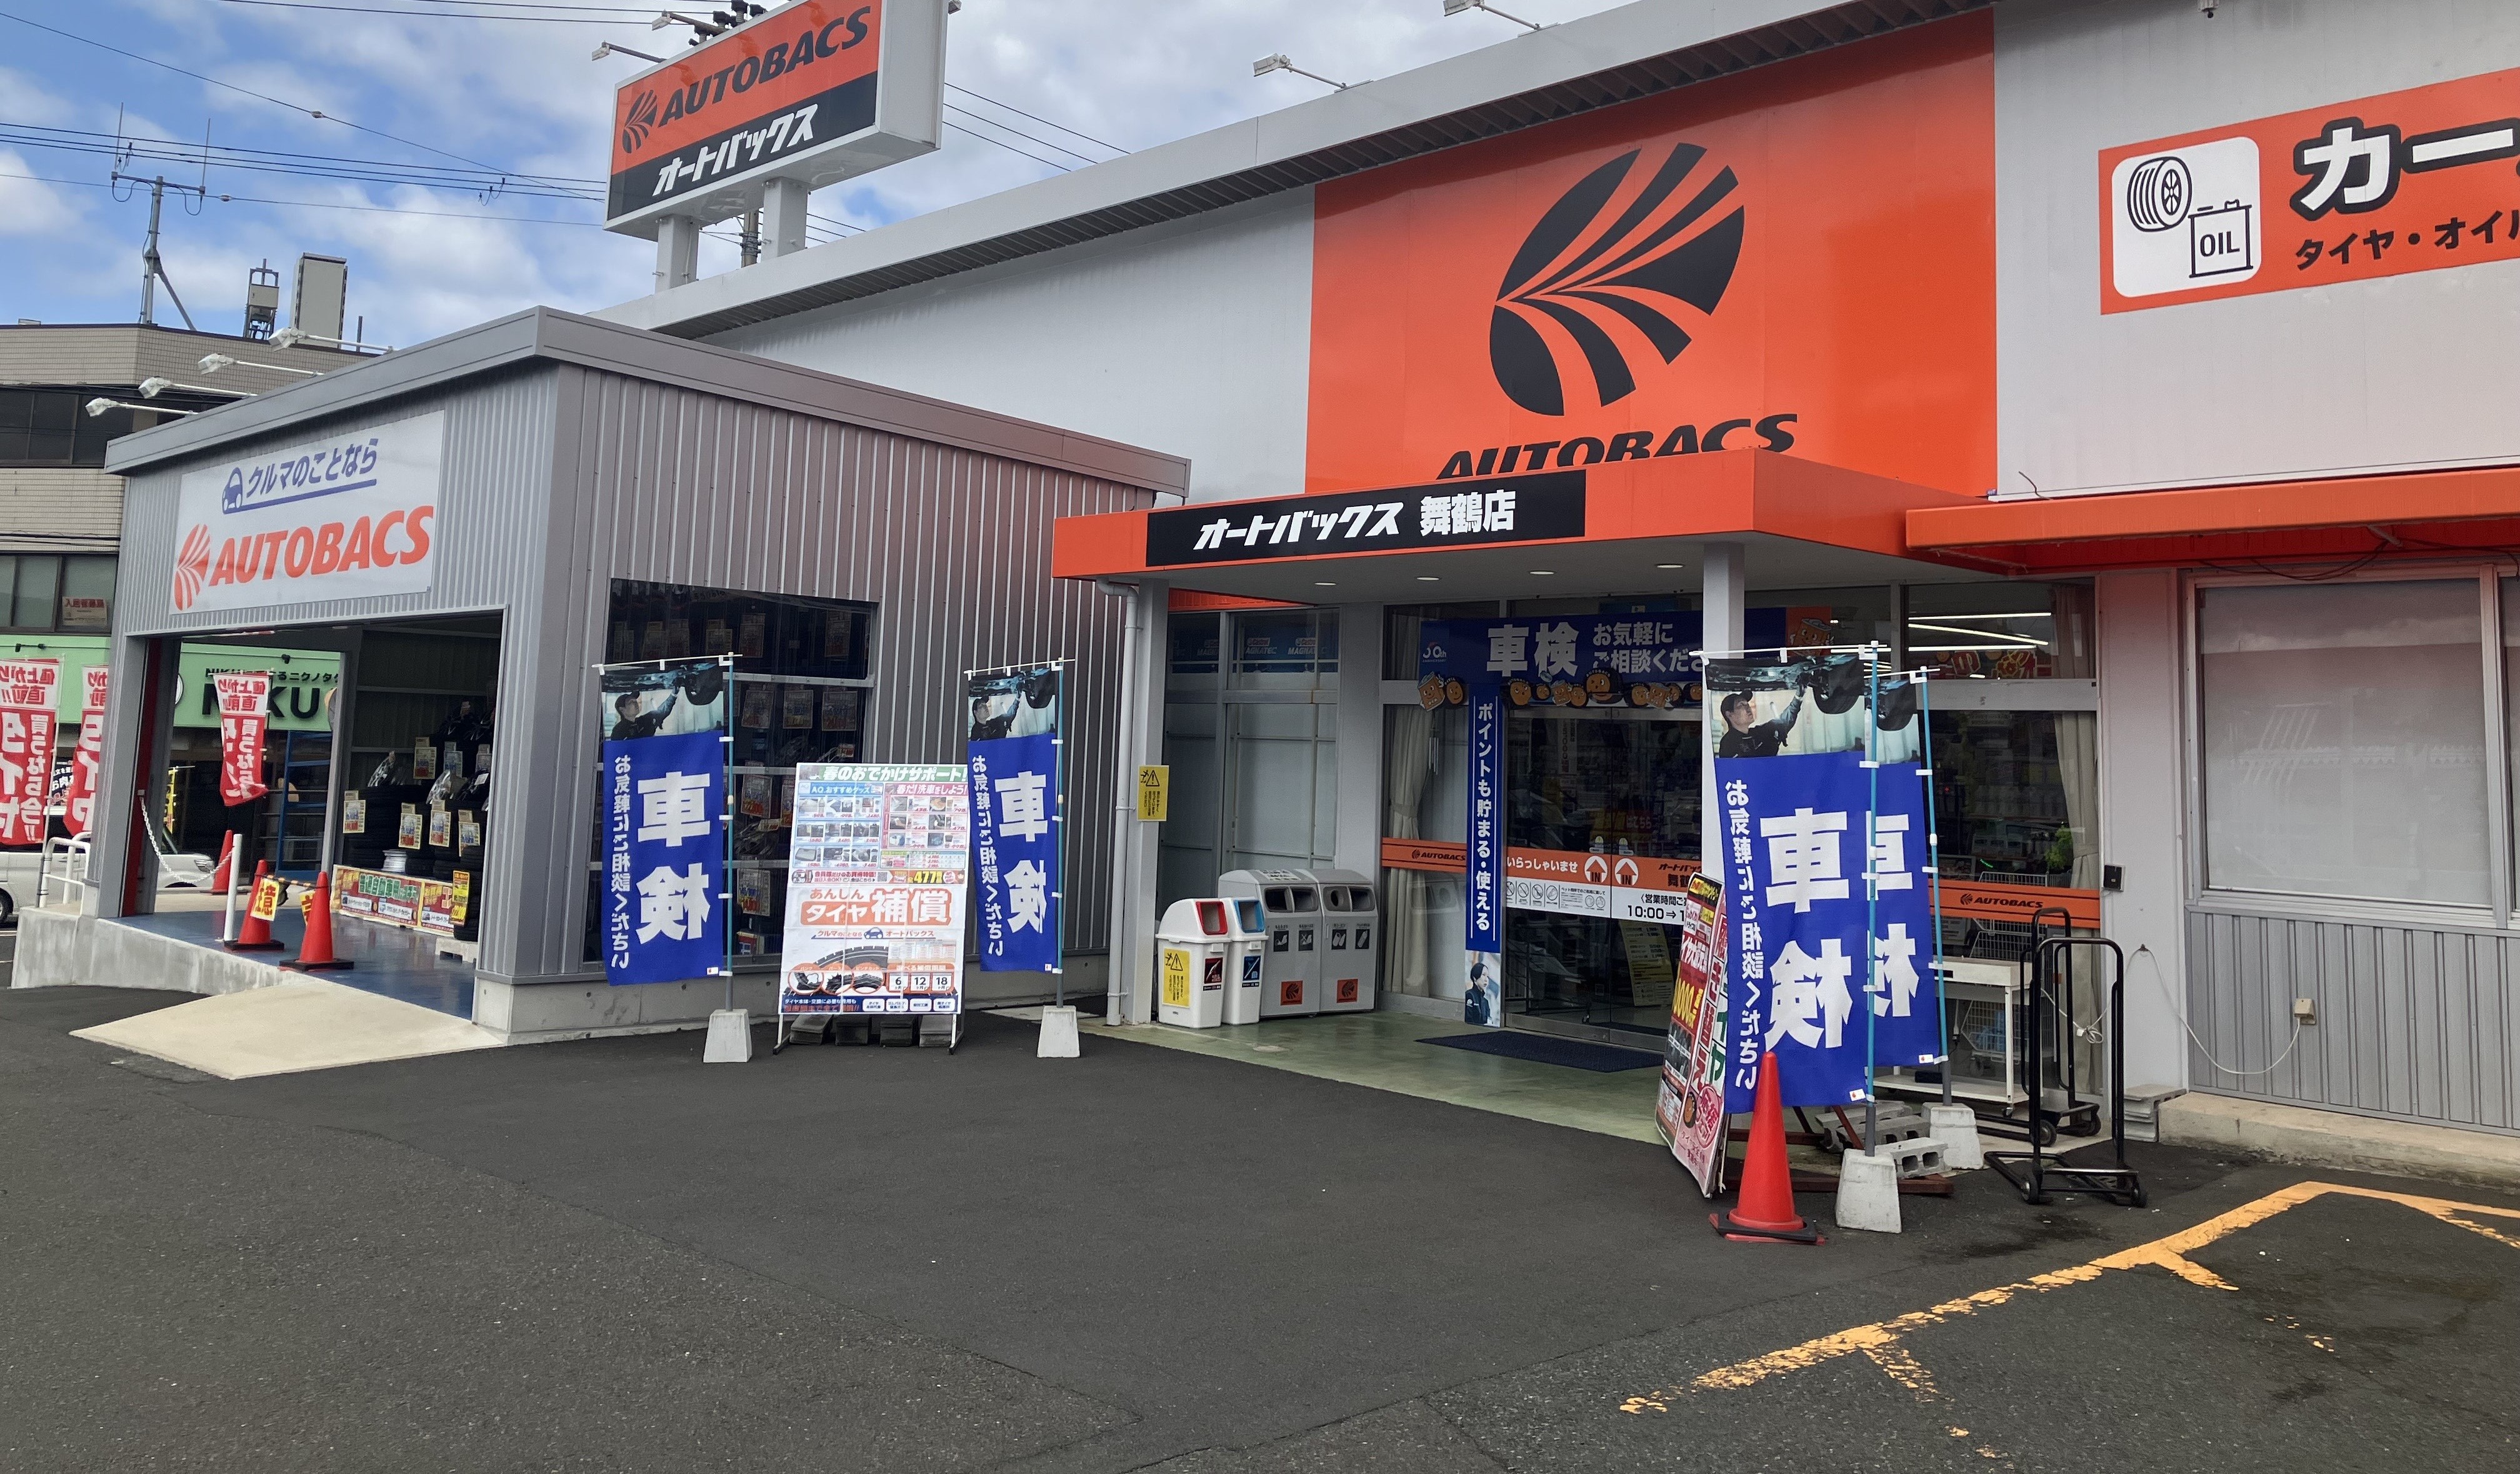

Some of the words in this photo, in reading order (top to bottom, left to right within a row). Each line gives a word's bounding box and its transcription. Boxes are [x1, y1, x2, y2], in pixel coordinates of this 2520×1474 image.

[658, 6, 871, 127] AUTOBACS
[652, 104, 818, 196] オートバックス
[2200, 231, 2240, 257] OIL
[246, 438, 379, 498] クルマのことなら
[1194, 502, 1404, 550] オートバックス
[1419, 489, 1516, 536] 舞鶴店
[209, 505, 434, 587] AUTOBACS
[1593, 621, 1674, 646] お気軽に
[1486, 621, 1579, 677] 車検
[202, 683, 321, 719] NKU
[823, 766, 968, 782] 春のおでかけサポート!
[896, 784, 968, 795] 春だ!洗車をしよう!
[1476, 703, 1494, 931] ポイントも貯まる・使える
[1421, 852, 1466, 861] AUTOBACS
[1507, 856, 1579, 874] いらっしゃいませ
[1591, 872, 1601, 883] IN
[1622, 875, 1631, 885] IN
[806, 890, 949, 923] タイヤ補償
[809, 888, 864, 900] あんしん
[1974, 897, 2044, 909] AUTOBACS
[914, 977, 926, 985] 12
[936, 977, 948, 985] 18
